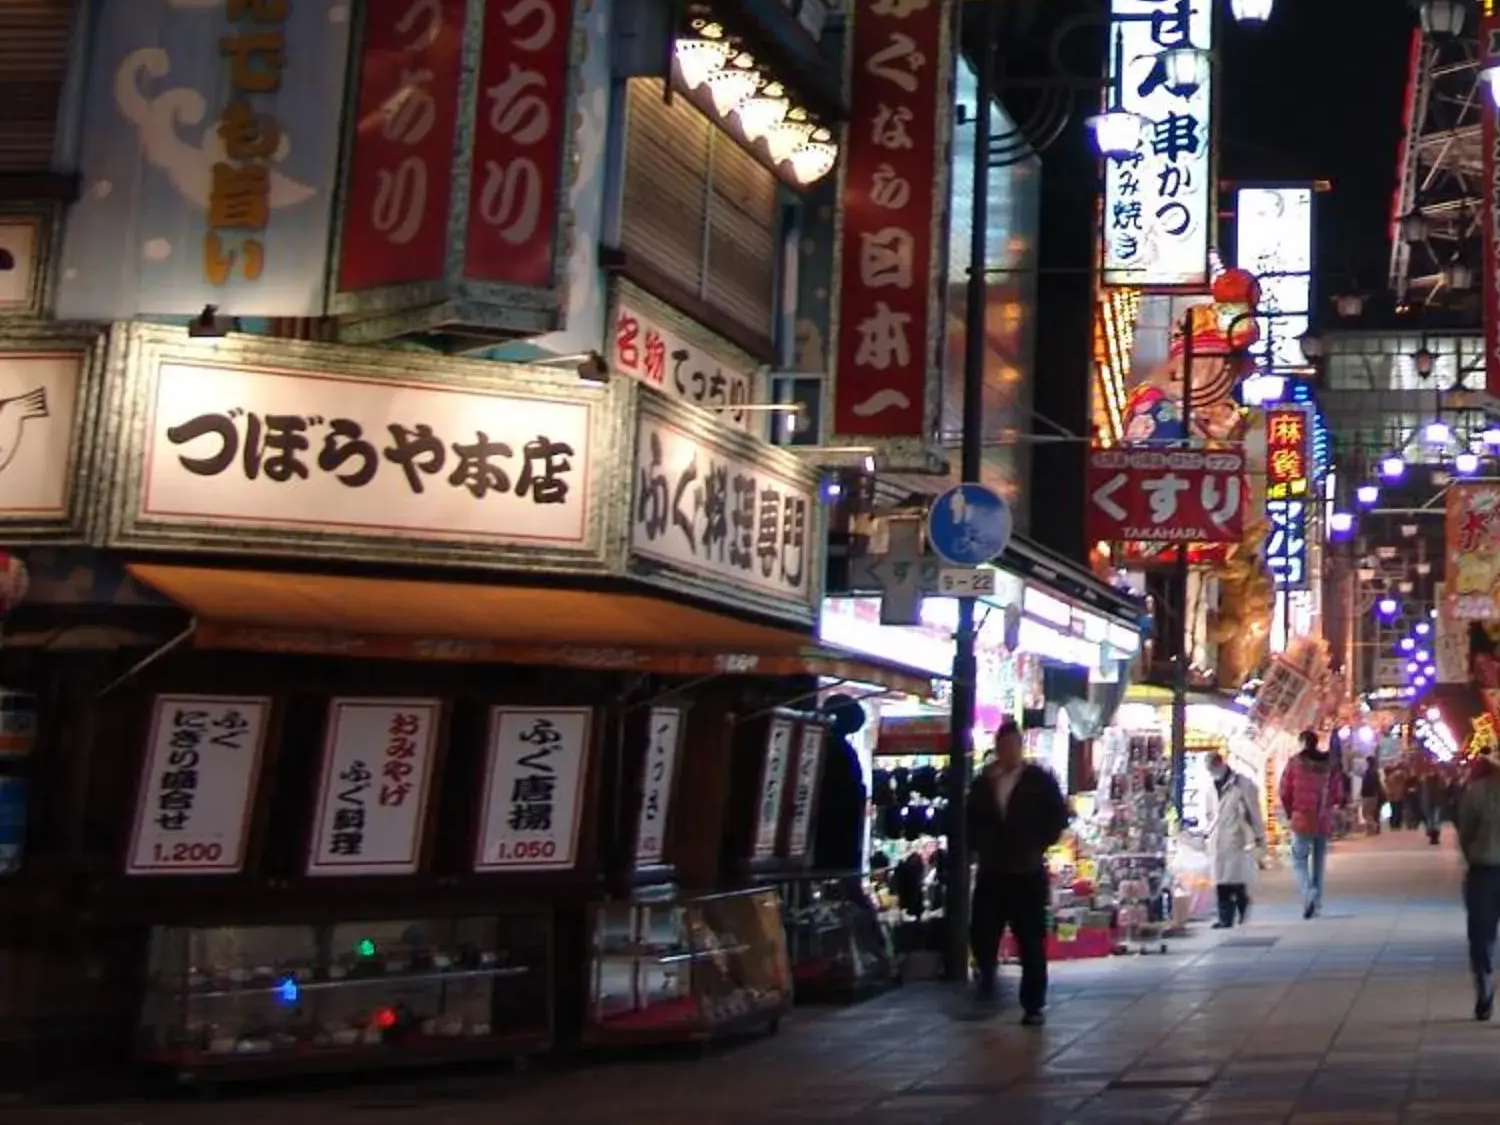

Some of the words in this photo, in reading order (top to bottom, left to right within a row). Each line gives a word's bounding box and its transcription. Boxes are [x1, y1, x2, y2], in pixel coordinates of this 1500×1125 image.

[1149, 111, 1199, 236] 串かつ
[618, 311, 665, 383] 名物
[672, 349, 746, 422] てっちり
[166, 408, 576, 506] づぼらや本店
[1091, 473, 1240, 525] くすり
[1122, 527, 1208, 540] TAKAHARA
[213, 711, 247, 750] ふぐ
